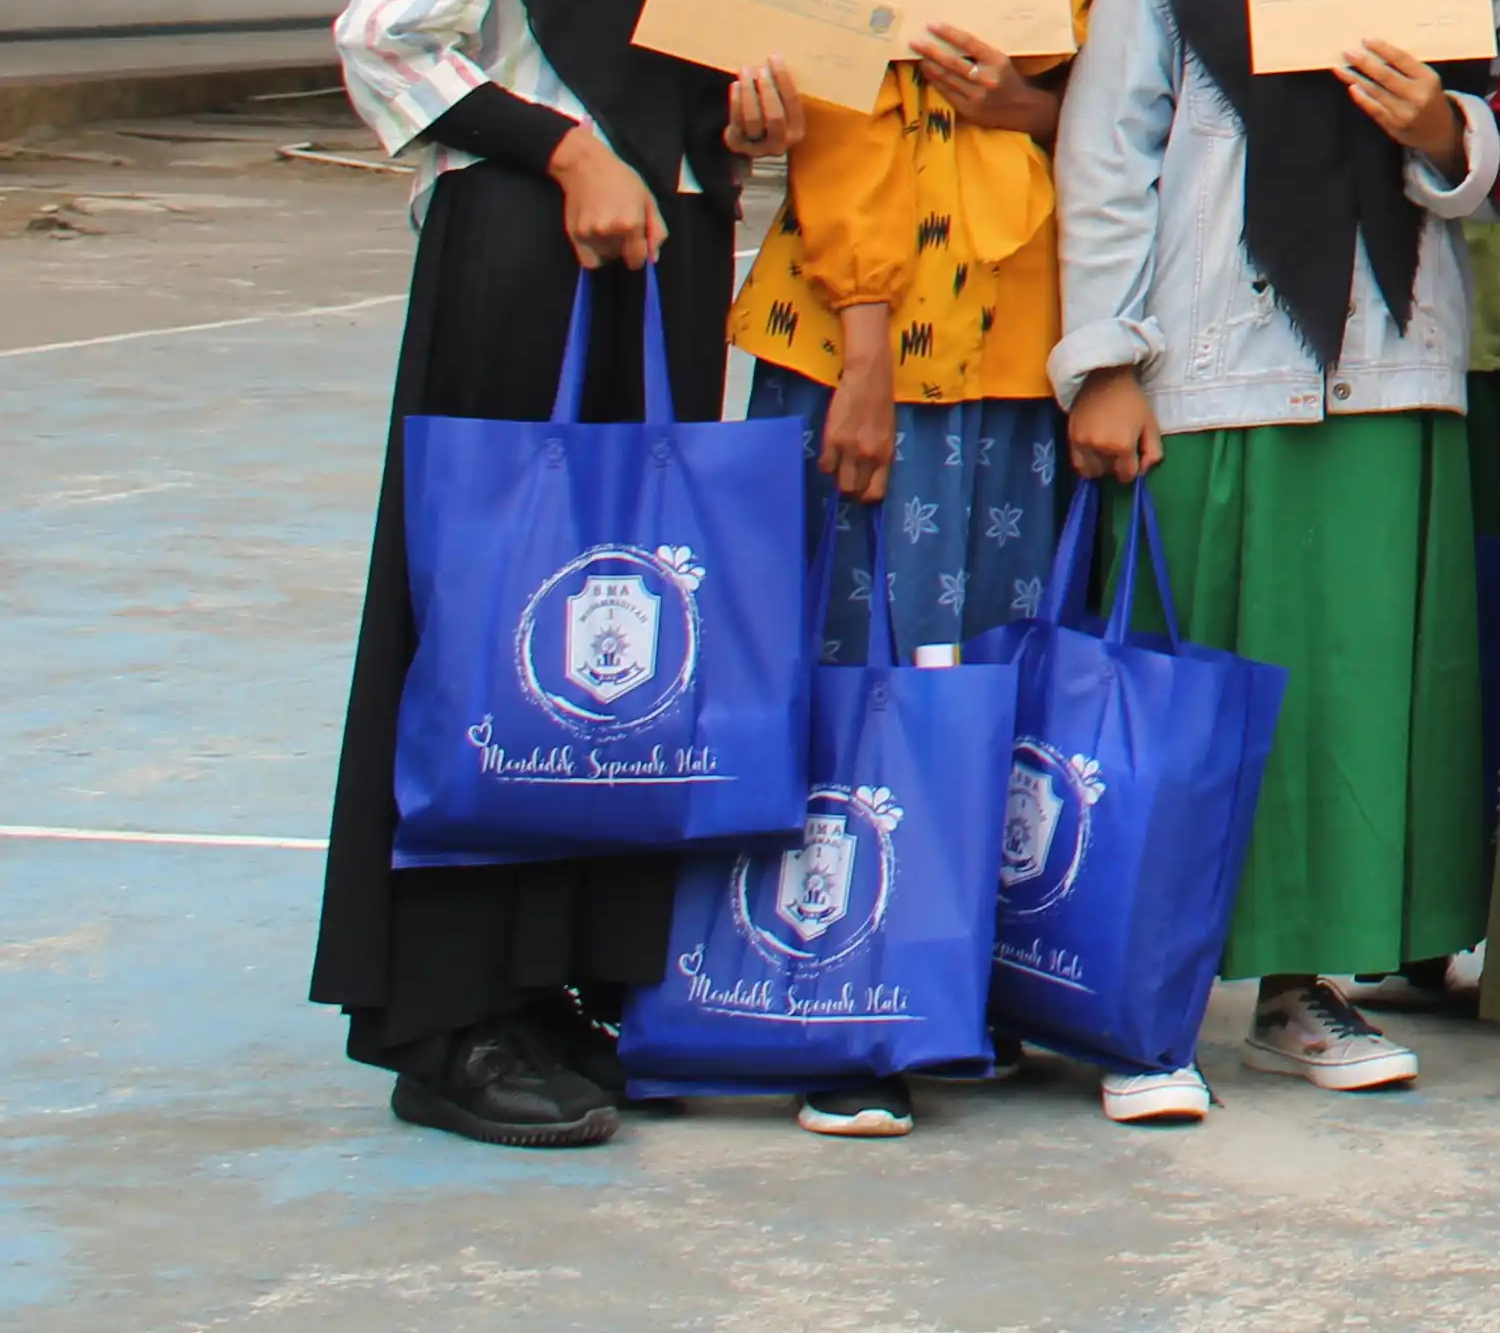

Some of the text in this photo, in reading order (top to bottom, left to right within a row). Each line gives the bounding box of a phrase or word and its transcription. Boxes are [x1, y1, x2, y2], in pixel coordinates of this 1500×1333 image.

[482, 744, 717, 787] Mendidik Sepenuh Hati
[688, 974, 909, 1025] Mendidik Sepenuh Hati
